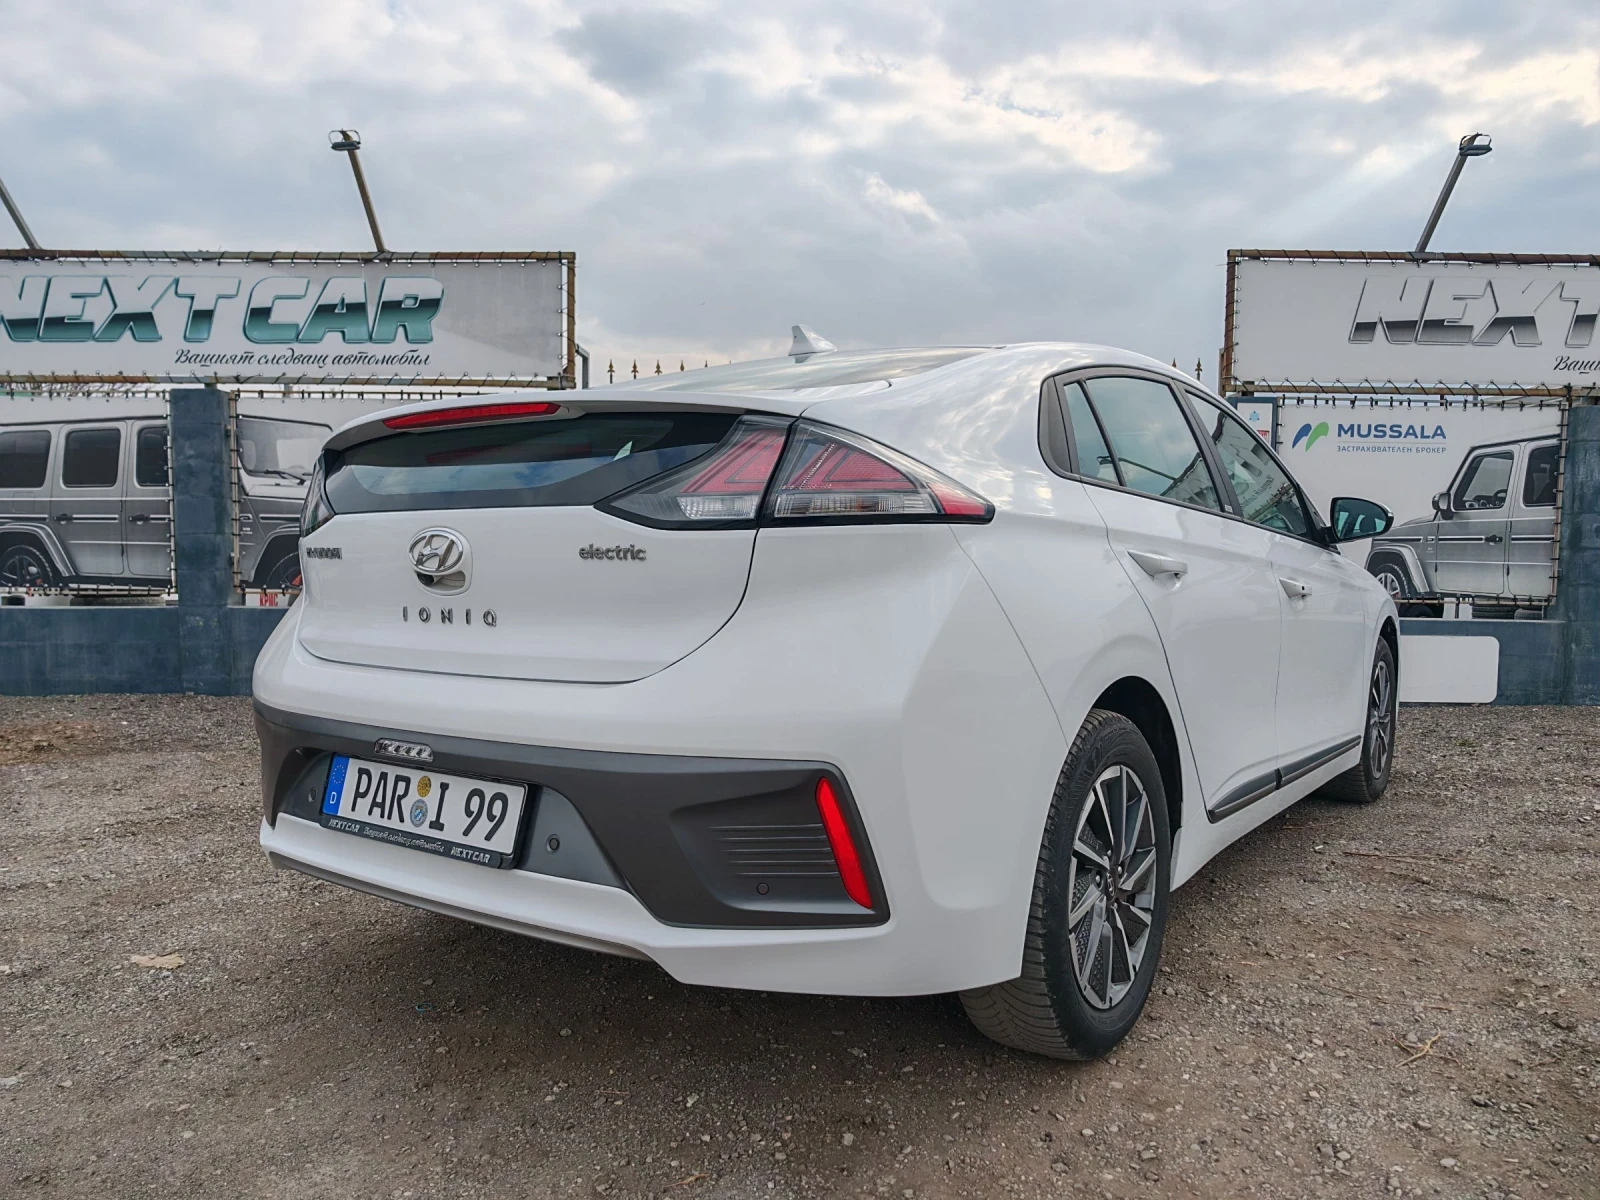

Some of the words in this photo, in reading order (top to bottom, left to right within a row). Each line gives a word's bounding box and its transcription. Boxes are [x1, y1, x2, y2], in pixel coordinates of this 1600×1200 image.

[174, 348, 255, 368] Вашият
[257, 348, 328, 369] следващ
[331, 349, 431, 366] автомобил
[1337, 423, 1447, 440] MUSSALA
[1336, 445, 1412, 454] ЗАСТРАХОВАТЕЛЕН
[1415, 446, 1447, 454] БРОКЕР
[578, 543, 647, 562] electric
[402, 606, 498, 628] IONIQ
[329, 791, 337, 804] D
[350, 767, 411, 824] PAR
[462, 787, 509, 842] 99
[328, 818, 360, 833] NEXTCAR
[450, 846, 491, 863] NEXTCAR
